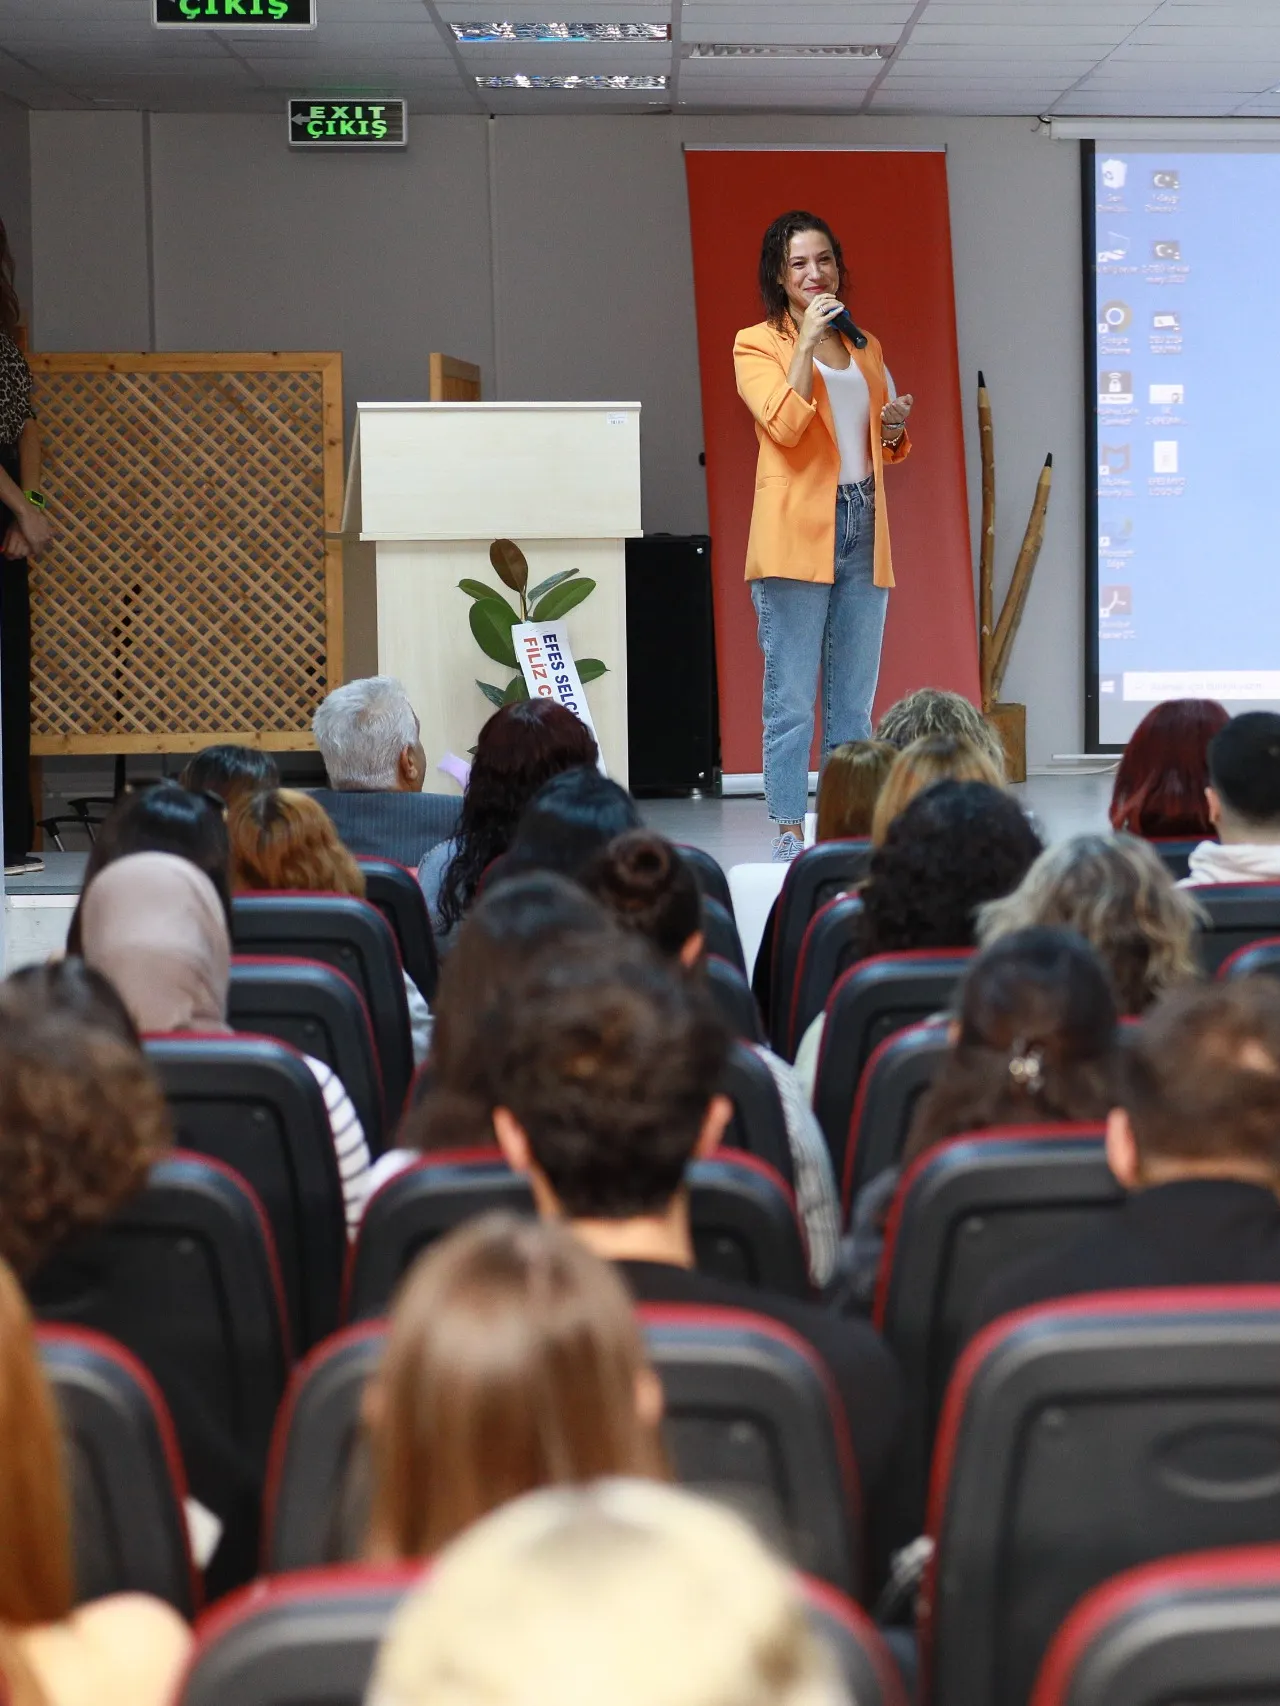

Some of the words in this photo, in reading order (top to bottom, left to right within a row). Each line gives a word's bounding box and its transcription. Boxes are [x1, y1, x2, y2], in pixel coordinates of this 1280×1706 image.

[179, 0, 289, 19] ÇIKIŞ
[310, 106, 386, 119] EXIT
[306, 120, 388, 139] ÇIKIŞ
[542, 633, 565, 671] EFES
[523, 637, 548, 680] FİLİZ
[537, 684, 555, 701] C
